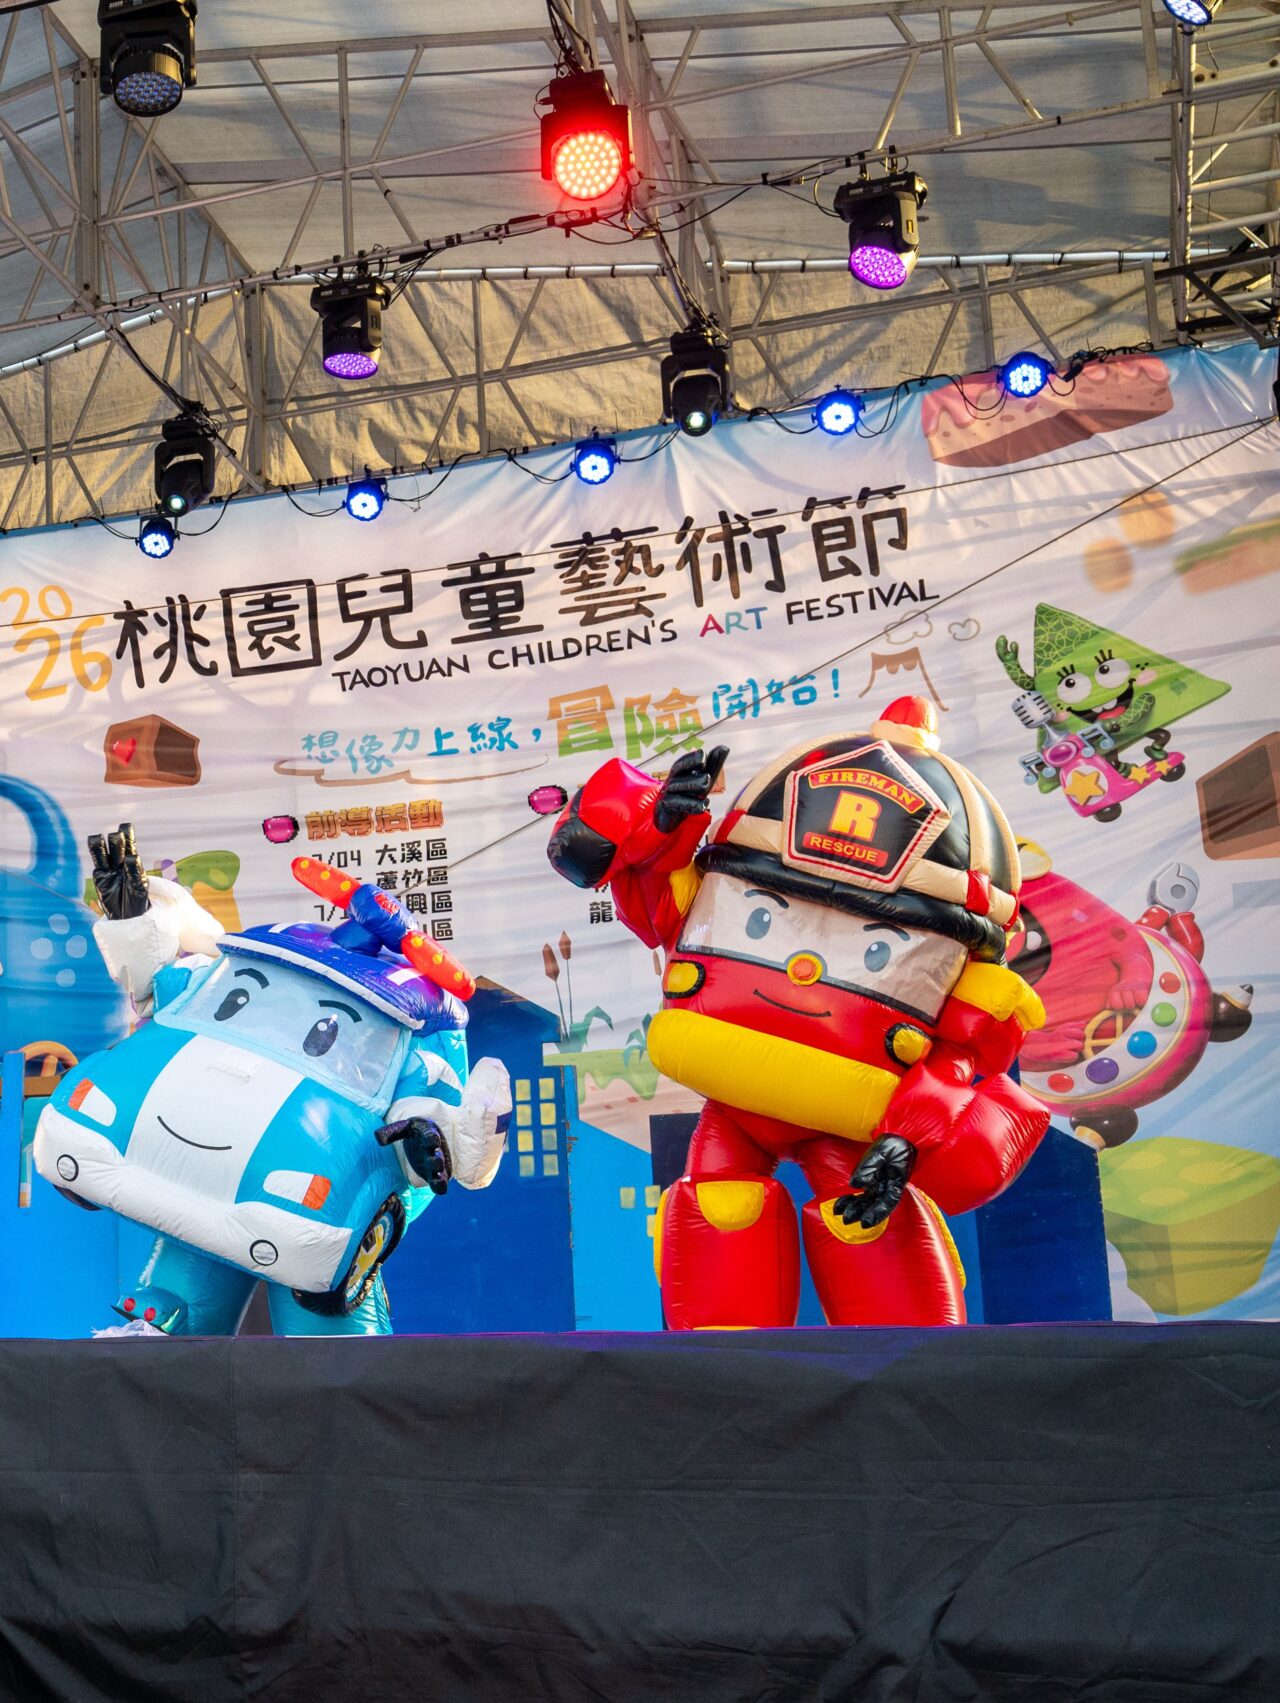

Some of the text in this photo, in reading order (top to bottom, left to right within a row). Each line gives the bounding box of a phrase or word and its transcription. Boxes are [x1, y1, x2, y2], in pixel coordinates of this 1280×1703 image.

[113, 483, 911, 690] 桃園兒童藝術節
[332, 579, 940, 692] TAOYUAN CHILDREN'S ART FESTIVAL
[14, 616, 113, 701] 26
[818, 772, 917, 808] FIREMAN
[306, 799, 446, 841] 前導活動
[830, 792, 879, 840] R
[375, 838, 448, 866] 大溪區
[809, 834, 878, 863] RESCUE
[375, 866, 448, 890] 蘆竹區
[395, 890, 453, 915] 興區
